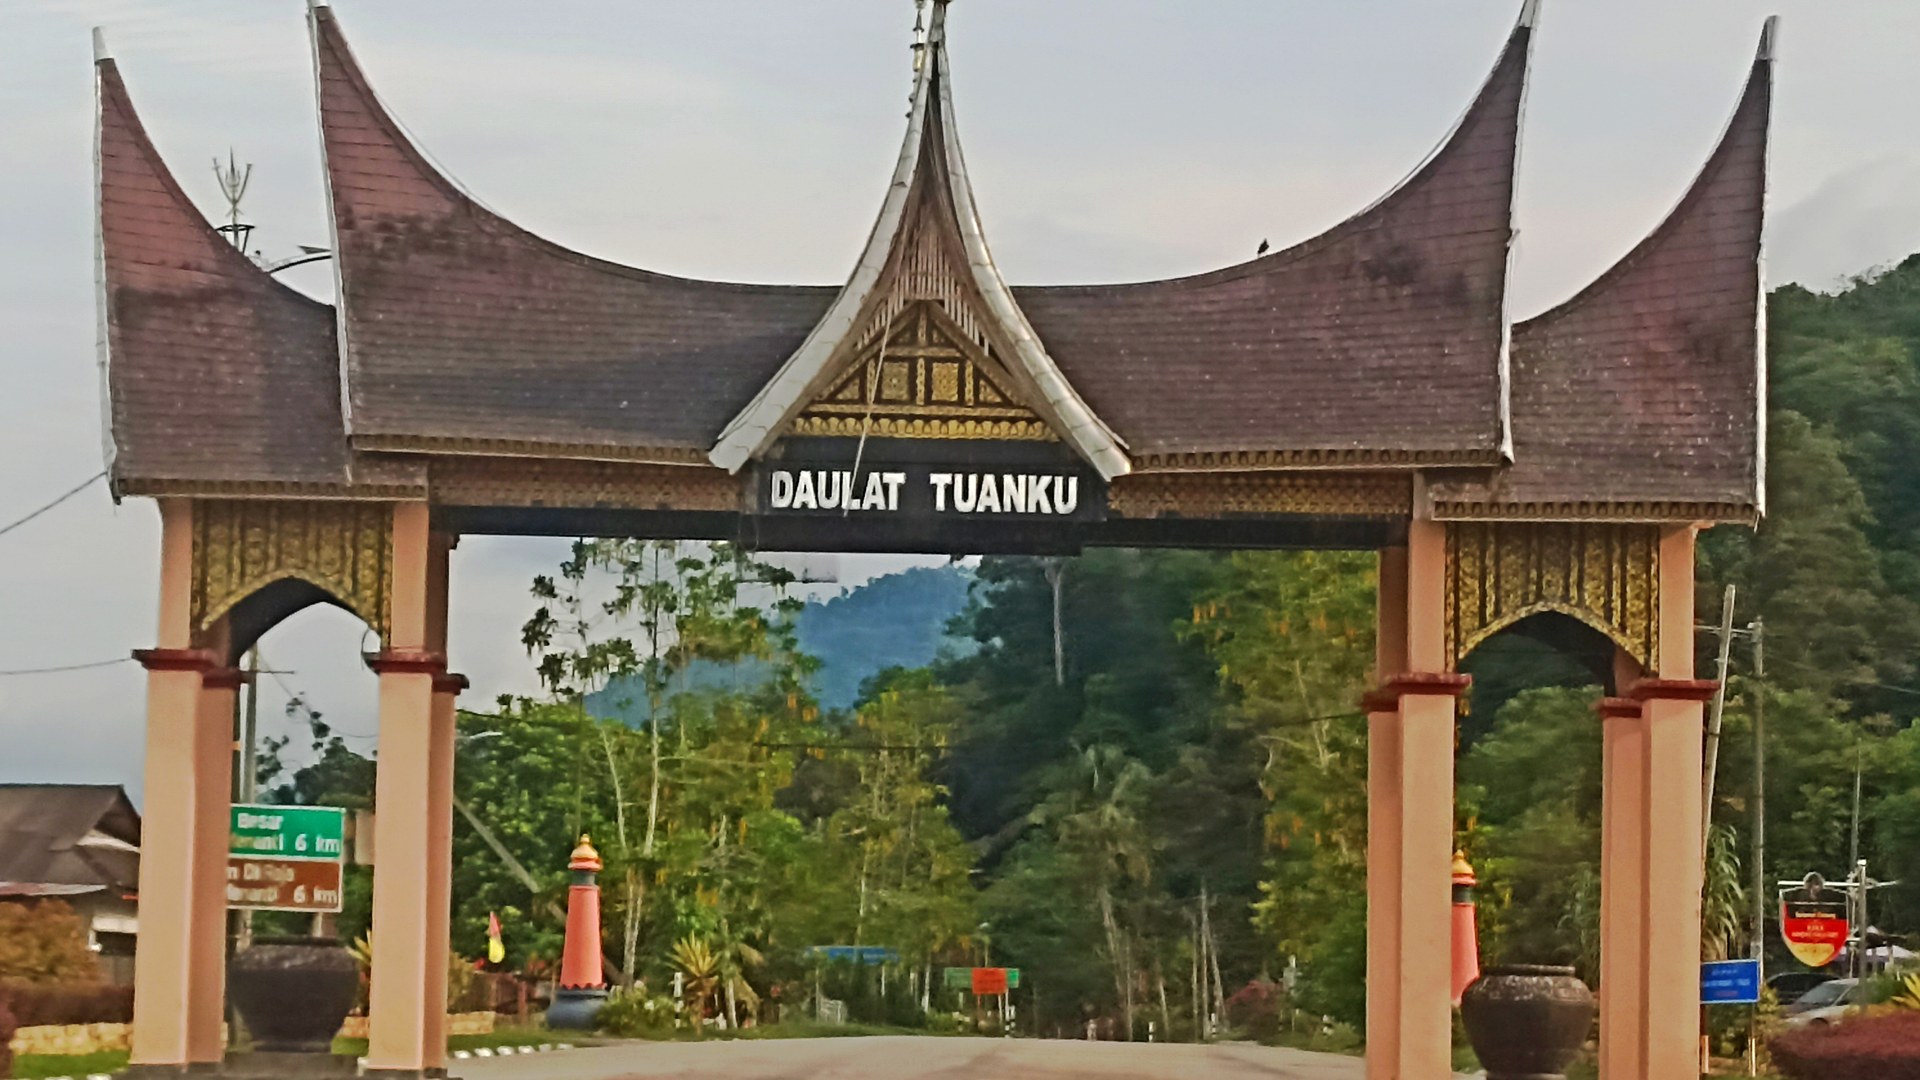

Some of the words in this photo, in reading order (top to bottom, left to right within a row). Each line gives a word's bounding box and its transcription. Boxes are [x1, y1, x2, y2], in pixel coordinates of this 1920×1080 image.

[771, 470, 906, 511] DAULAT
[930, 473, 1078, 514] TUANKU
[295, 834, 307, 851] 6
[316, 835, 339, 852] km
[294, 885, 306, 903] 6
[313, 886, 337, 903] km
